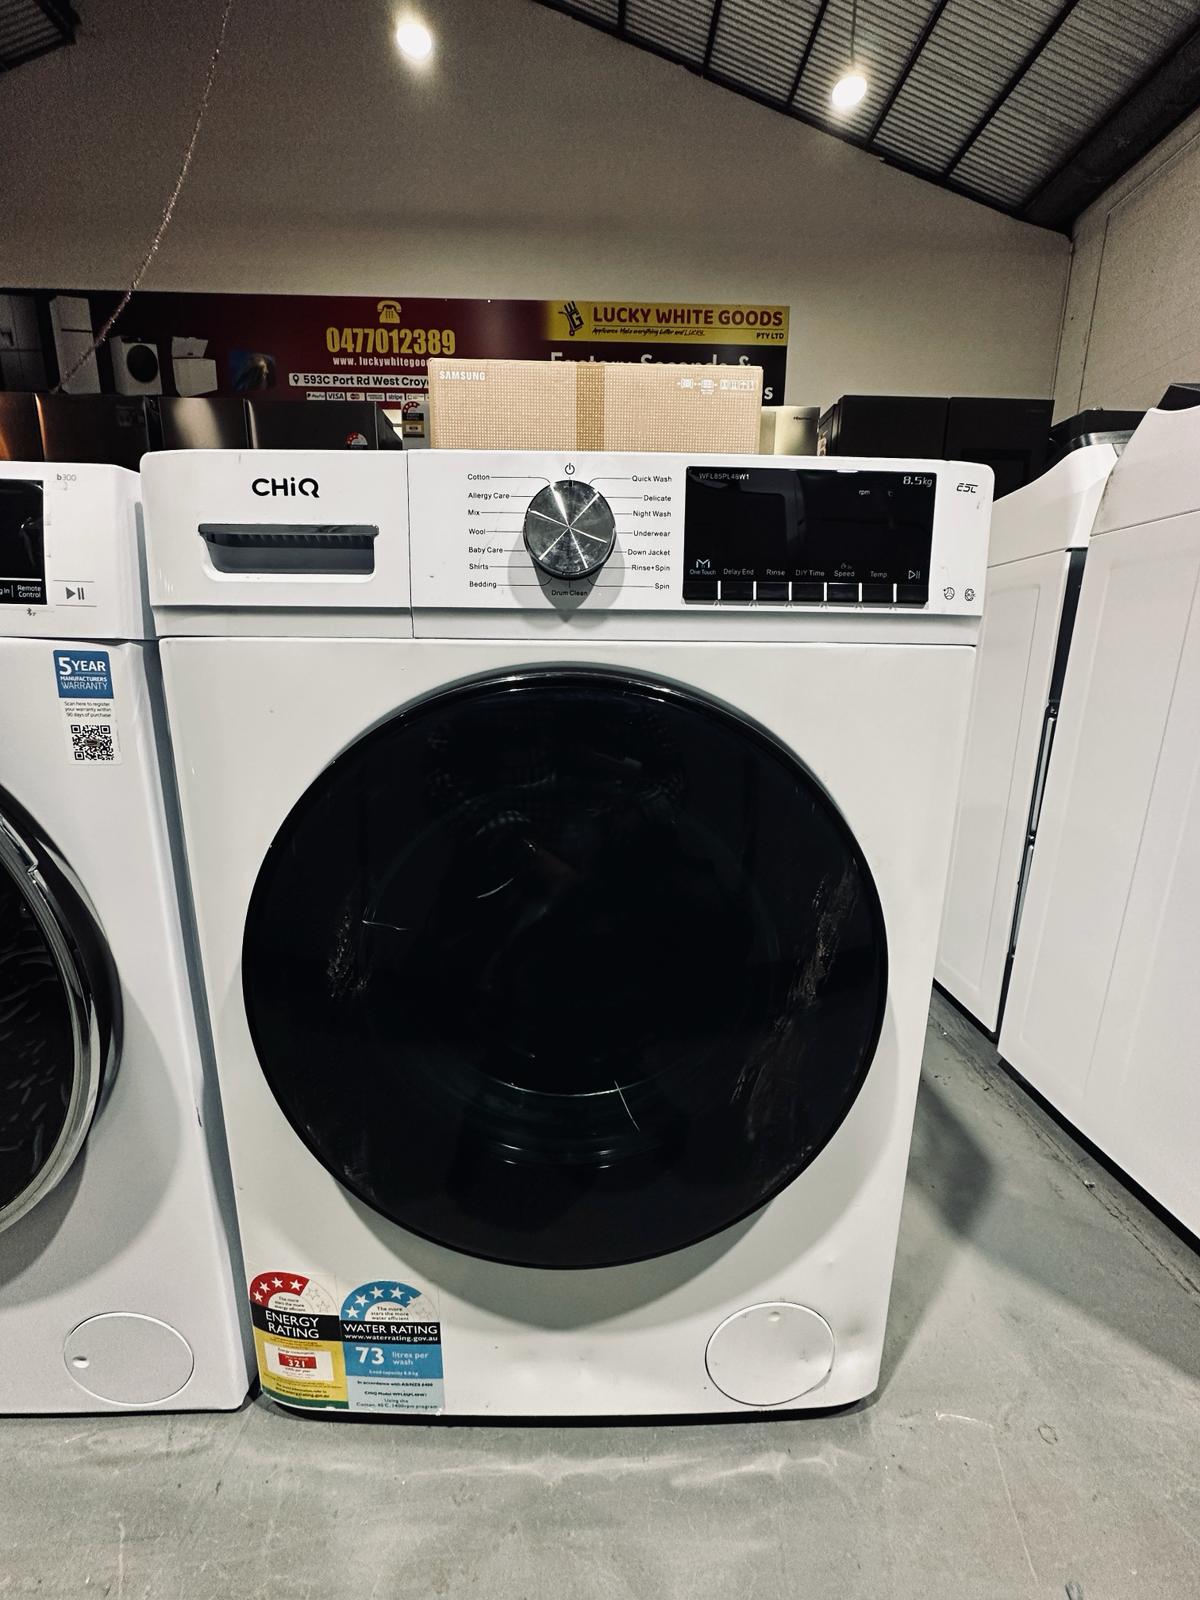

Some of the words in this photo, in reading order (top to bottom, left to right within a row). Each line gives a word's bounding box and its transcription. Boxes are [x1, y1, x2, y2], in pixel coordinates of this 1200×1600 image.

[592, 306, 651, 323] LUCKY
[656, 308, 714, 325] WHITE
[718, 310, 783, 326] GOODS
[756, 332, 769, 340] PTY
[771, 332, 784, 340] LTD
[325, 326, 456, 355] 0477012389
[439, 370, 486, 381] SAMSUNG
[303, 375, 331, 385] 593C
[332, 376, 354, 386] Port
[356, 376, 370, 386] Rd
[372, 377, 399, 386] West
[632, 475, 652, 483] Quick
[902, 475, 932, 488] 8.5kg
[251, 476, 320, 498] CHiQ
[468, 492, 492, 501] Allergy
[643, 494, 672, 502] Delicate
[632, 510, 651, 519] Night
[652, 510, 672, 518] Wash
[468, 546, 485, 555] Baby
[486, 546, 504, 554] Care
[627, 548, 646, 556] Down
[648, 548, 671, 556] Jacket
[723, 568, 740, 576] Delay
[741, 568, 755, 576] End
[766, 568, 786, 576] Rinse
[809, 569, 825, 577] Time
[834, 570, 855, 578] Speed
[17, 584, 42, 592] Remote
[469, 580, 496, 588] Bedding
[654, 582, 670, 590] Spin
[551, 589, 569, 597] Drum
[570, 589, 588, 597] Clean
[58, 656, 71, 675] 5
[71, 660, 106, 672] YEAR
[61, 682, 108, 690] WARRANTY
[265, 1310, 319, 1327] ENERGY
[268, 1322, 319, 1338] RATING
[344, 1323, 386, 1334] WATER
[390, 1324, 437, 1335] RATING
[345, 1334, 437, 1342] www.waterrating.gov.au
[355, 1346, 385, 1365] 73
[414, 1352, 428, 1360] per
[288, 1359, 305, 1368] 321
